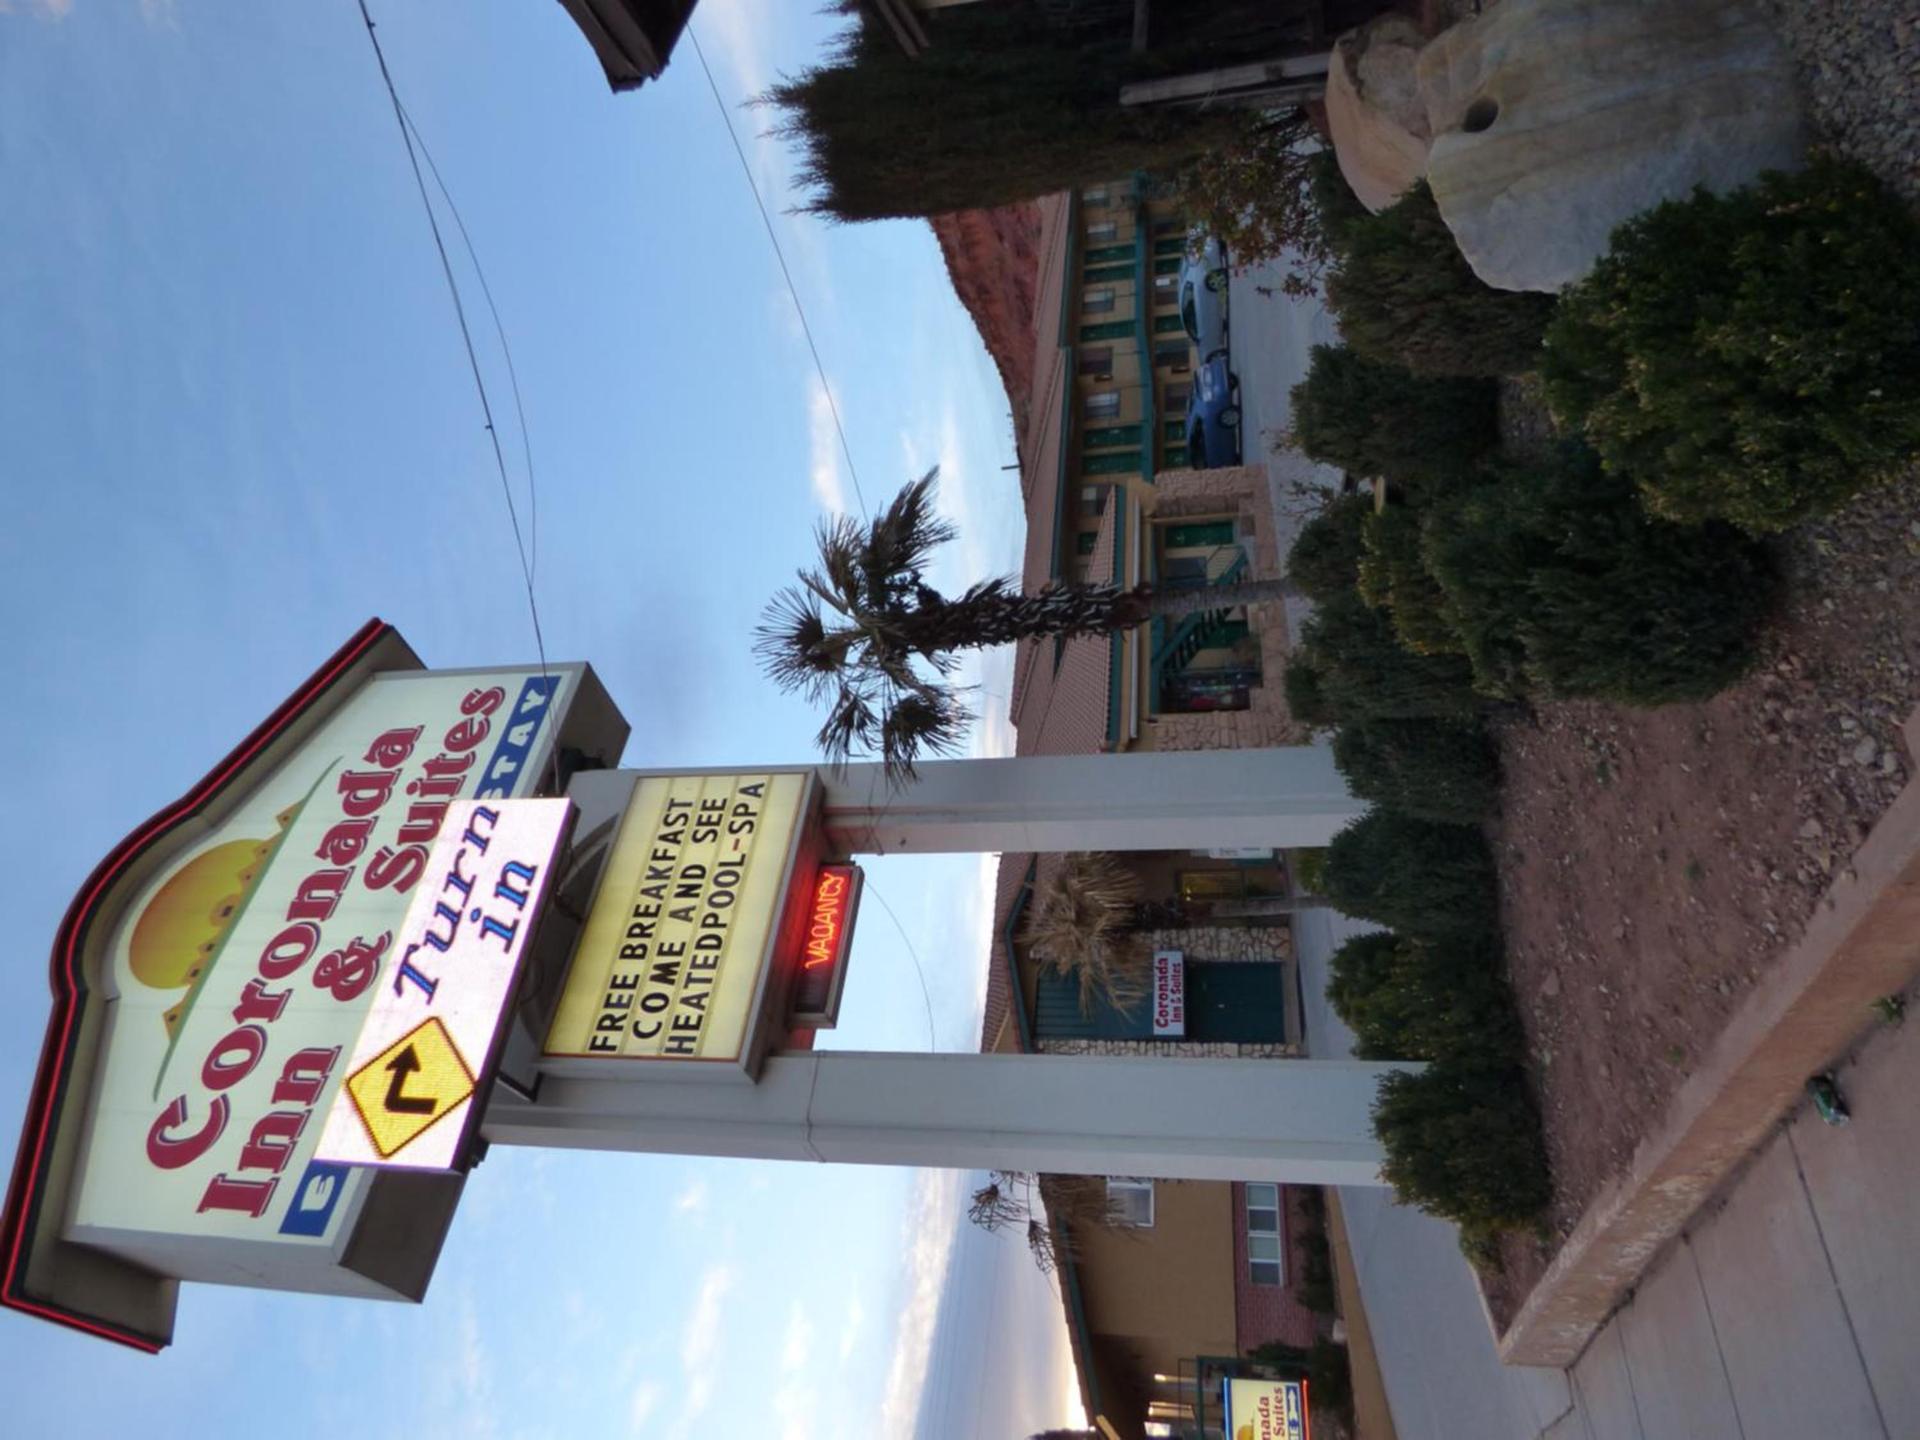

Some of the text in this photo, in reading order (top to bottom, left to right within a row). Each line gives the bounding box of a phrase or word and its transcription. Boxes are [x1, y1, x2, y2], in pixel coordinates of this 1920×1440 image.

[145, 723, 425, 1170] Coronada
[195, 685, 506, 1219] Inn & Suites
[392, 804, 501, 1006] Turn
[469, 859, 538, 955] in
[588, 797, 694, 1053] FREE BREAKFAST
[632, 797, 728, 1040] COME AND SEE
[803, 871, 846, 969] VACANCY
[1154, 957, 1169, 1029] Coronada
[1169, 962, 1182, 995] Suites
[1169, 1005, 1182, 1024] Inn
[1272, 1387, 1286, 1437] Suites
